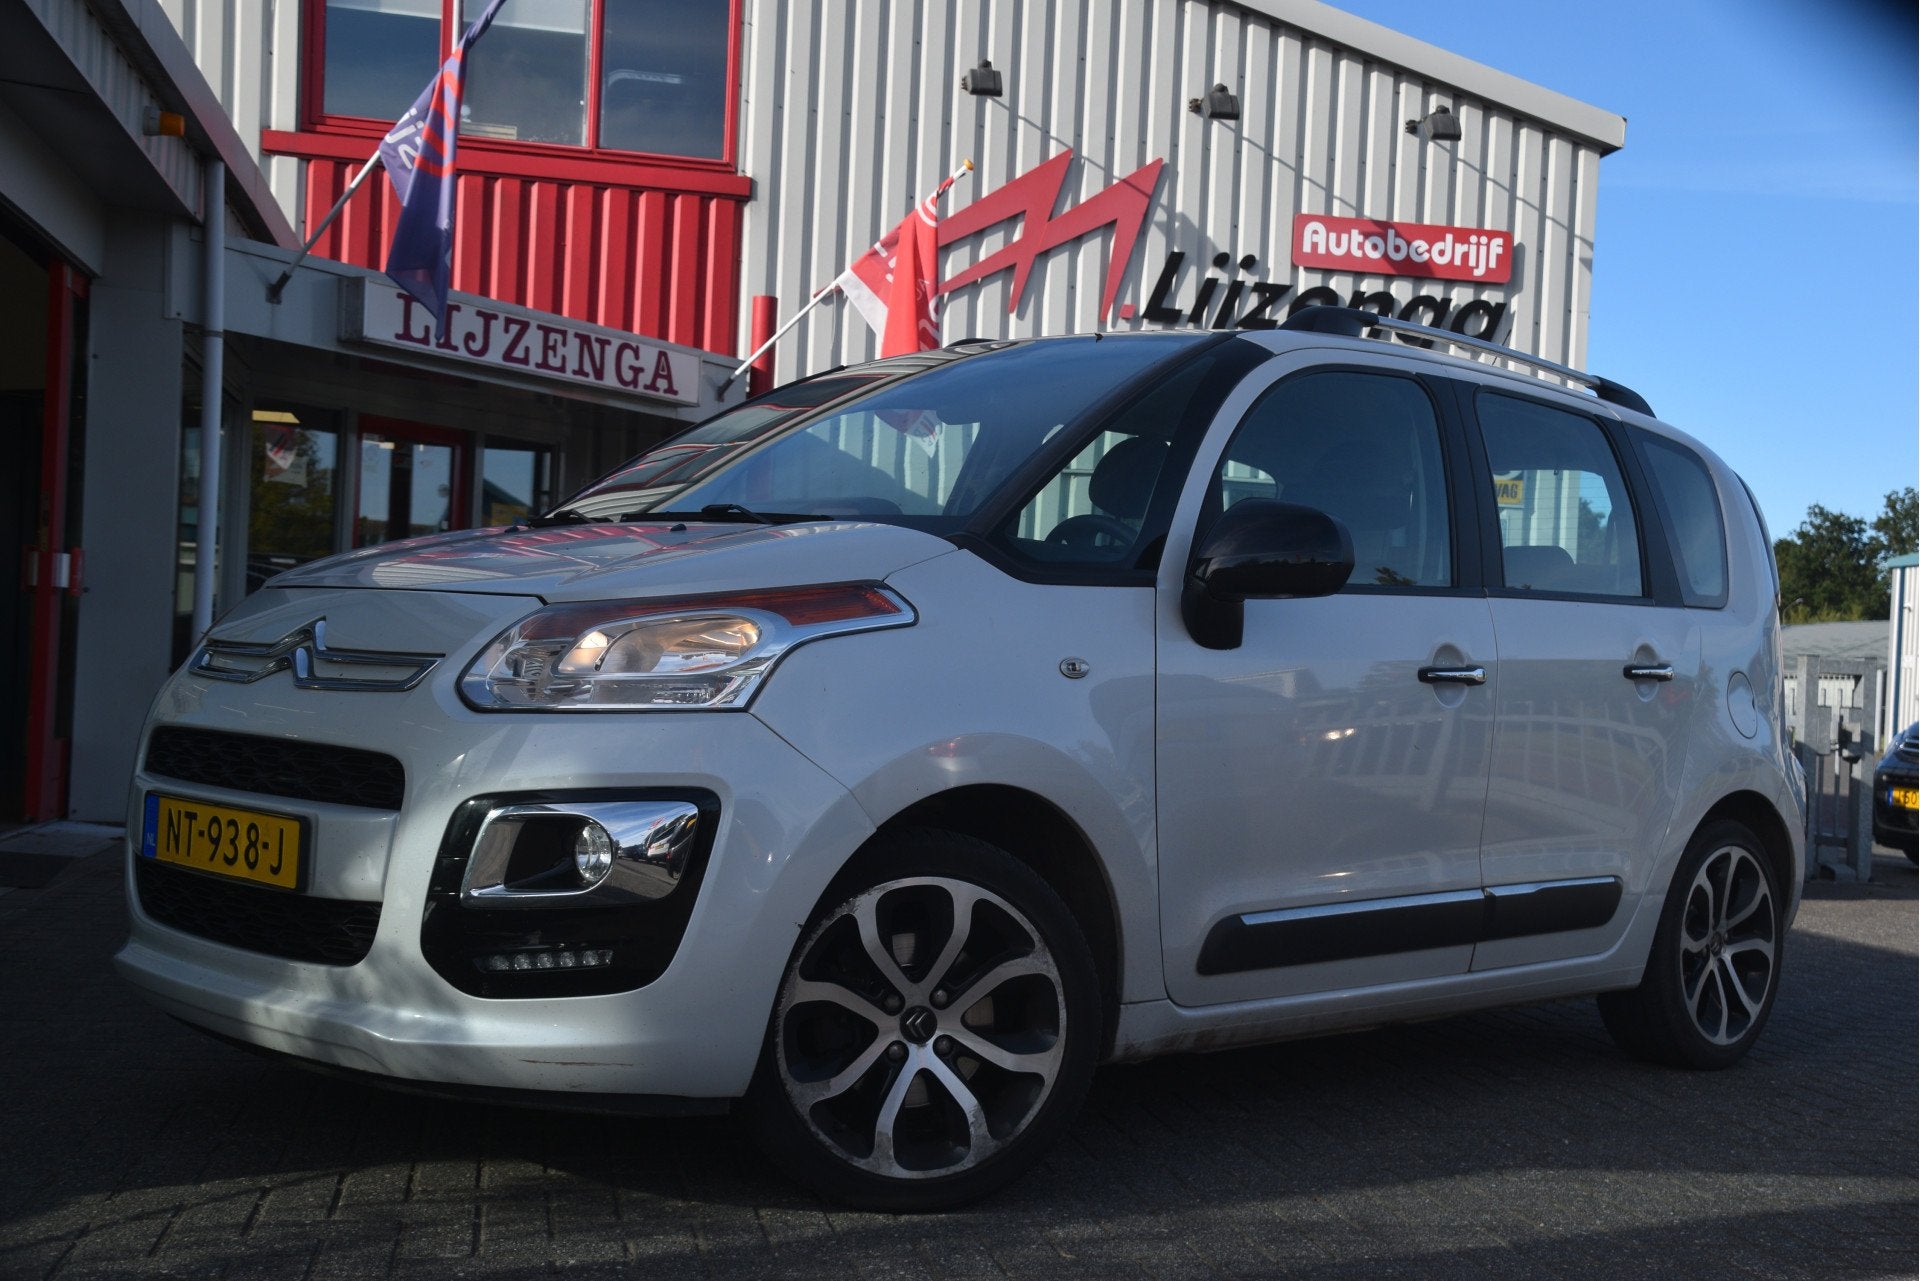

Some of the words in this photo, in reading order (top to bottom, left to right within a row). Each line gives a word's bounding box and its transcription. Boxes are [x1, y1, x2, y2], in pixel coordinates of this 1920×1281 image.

[1302, 220, 1504, 277] Autobedrijf
[395, 292, 679, 396] LIJZENGA
[166, 808, 284, 875] NT-938-J
